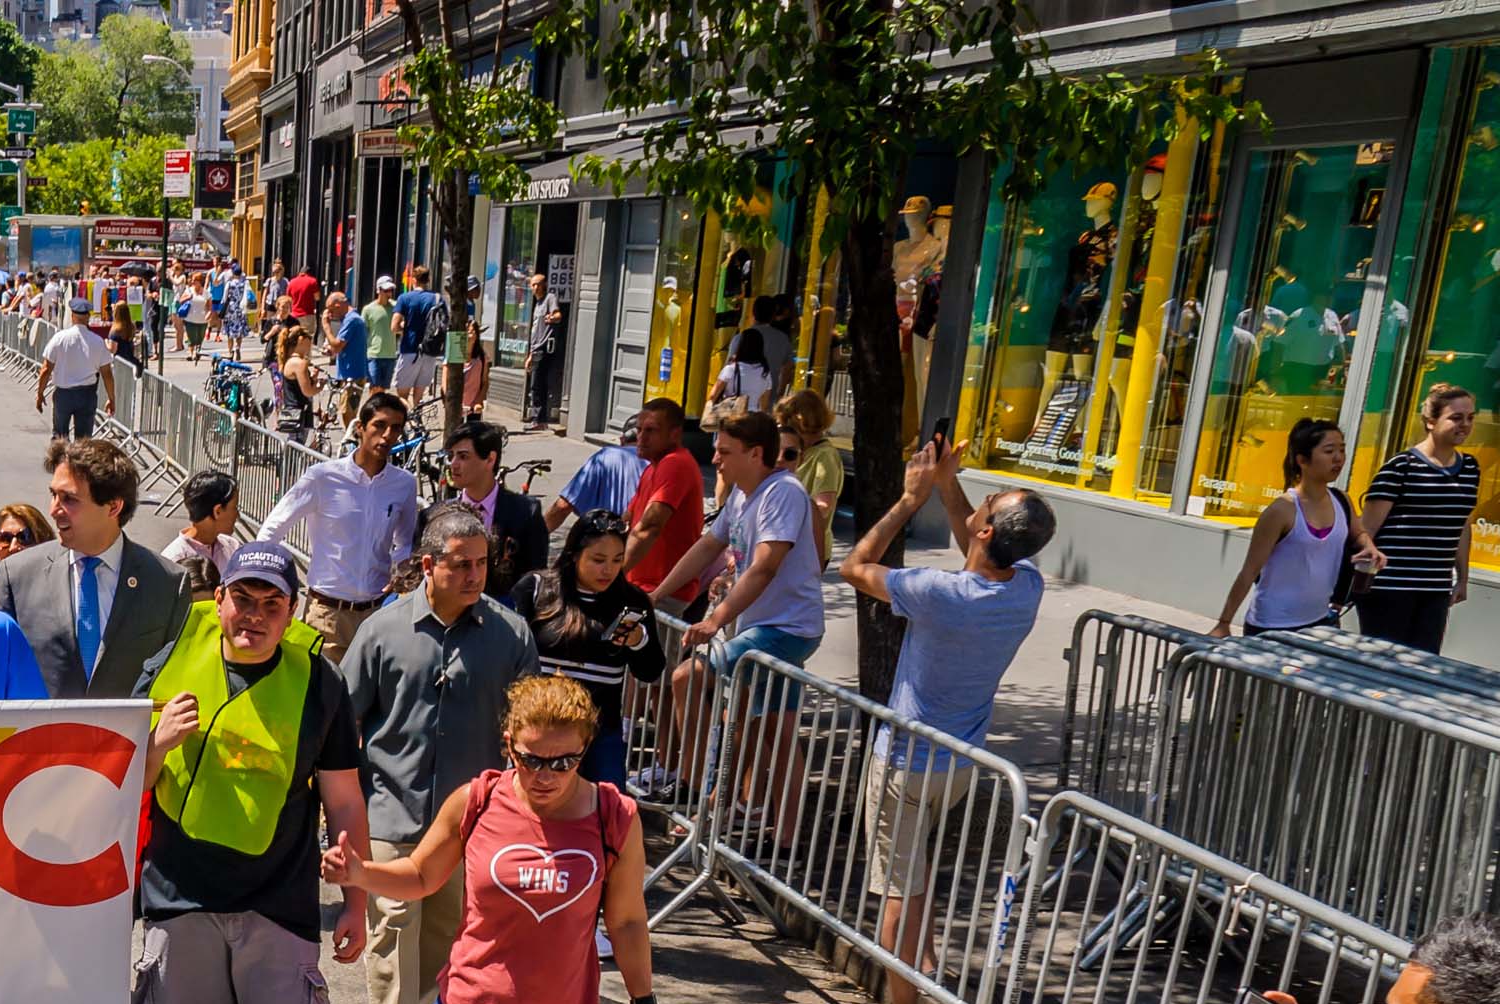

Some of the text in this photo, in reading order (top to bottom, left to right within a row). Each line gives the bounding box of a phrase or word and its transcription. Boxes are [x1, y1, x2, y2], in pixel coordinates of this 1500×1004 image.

[541, 178, 571, 199] SPORTS
[100, 226, 120, 234] YEARS
[130, 227, 157, 235] SERVICE
[996, 438, 1025, 454] Paragon
[1198, 474, 1237, 493] Paragon
